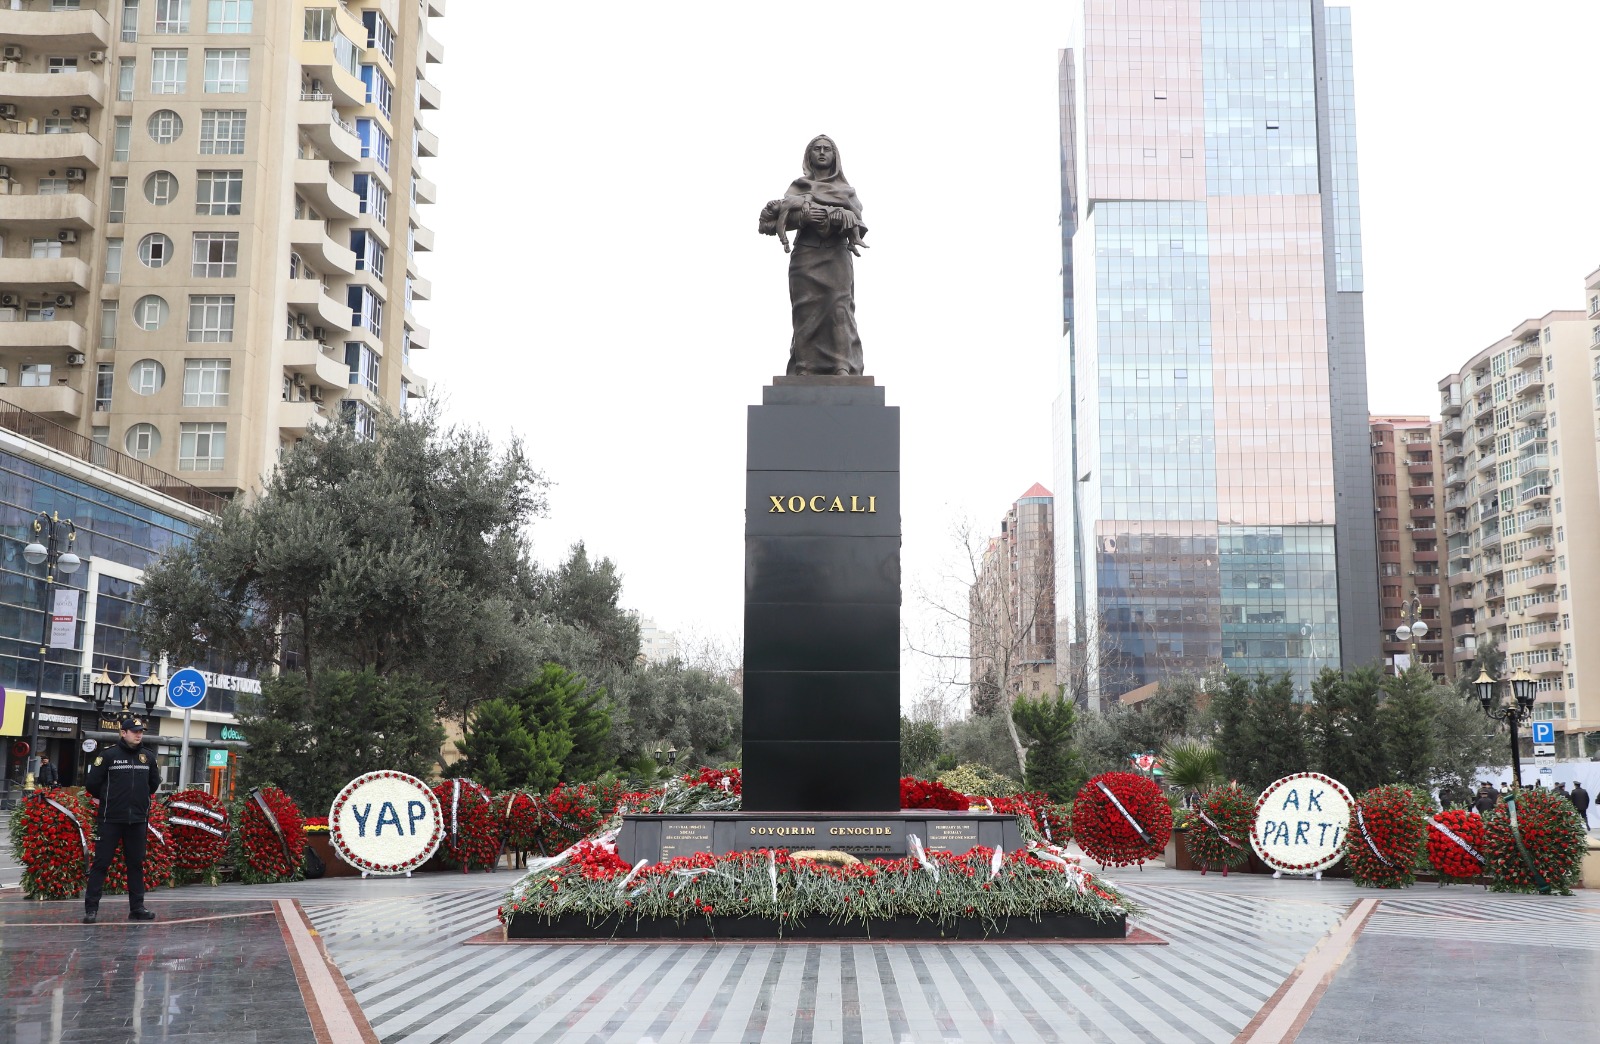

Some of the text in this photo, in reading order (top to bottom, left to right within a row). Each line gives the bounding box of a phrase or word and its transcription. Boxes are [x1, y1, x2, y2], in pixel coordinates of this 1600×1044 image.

[768, 495, 877, 513] XOCALI
[1537, 724, 1549, 741] P
[352, 800, 426, 837] YAP
[750, 826, 892, 837] SOYQIRIM GENOCIDE
[1262, 820, 1341, 848] PARTİ
